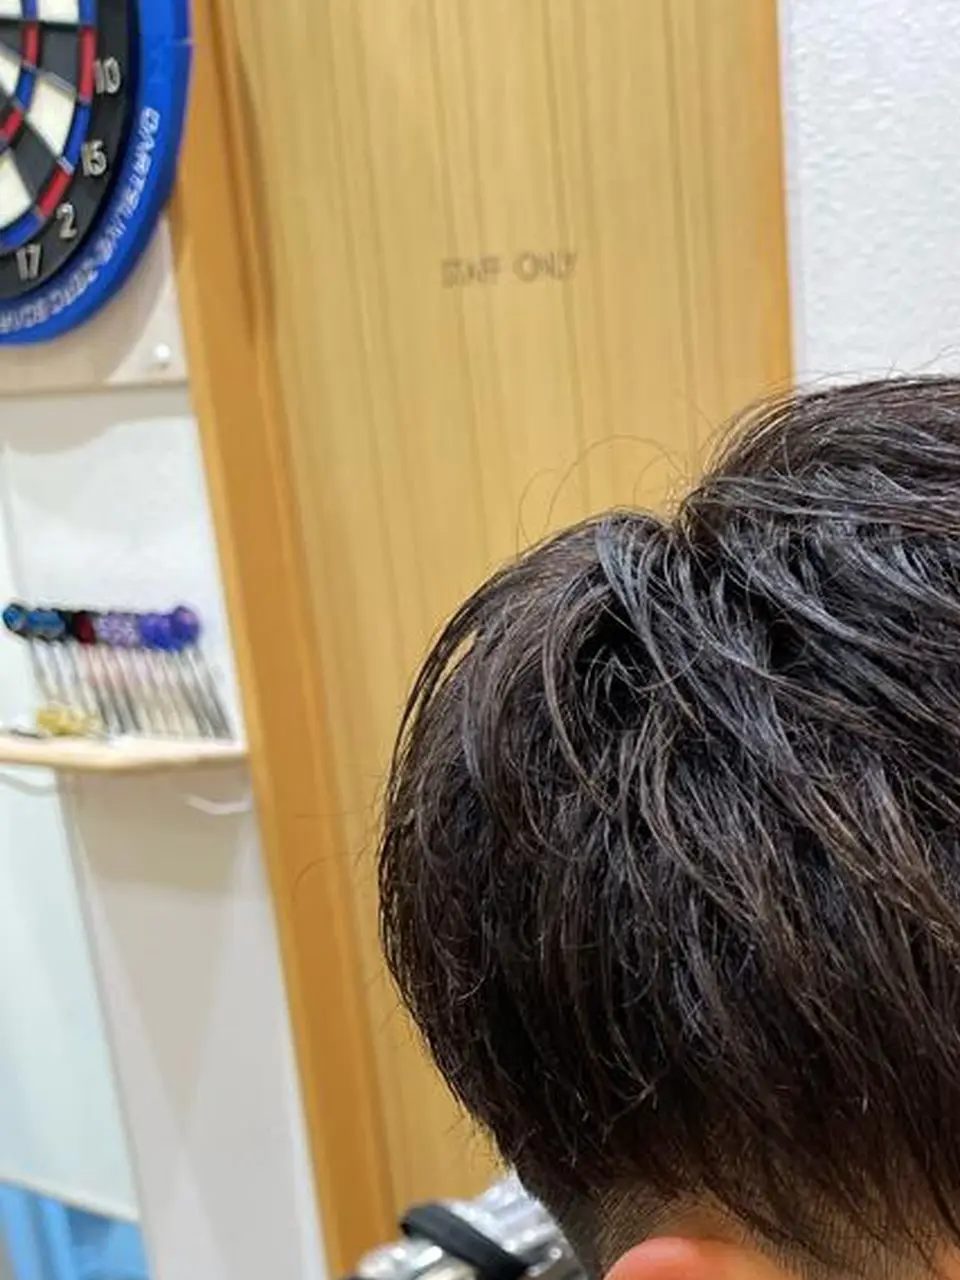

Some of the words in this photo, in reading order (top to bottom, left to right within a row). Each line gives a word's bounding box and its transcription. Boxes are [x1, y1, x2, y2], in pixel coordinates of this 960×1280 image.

[93, 56, 121, 95] 10
[81, 139, 107, 176] 15
[56, 202, 77, 239] 2
[16, 243, 41, 281] 17
